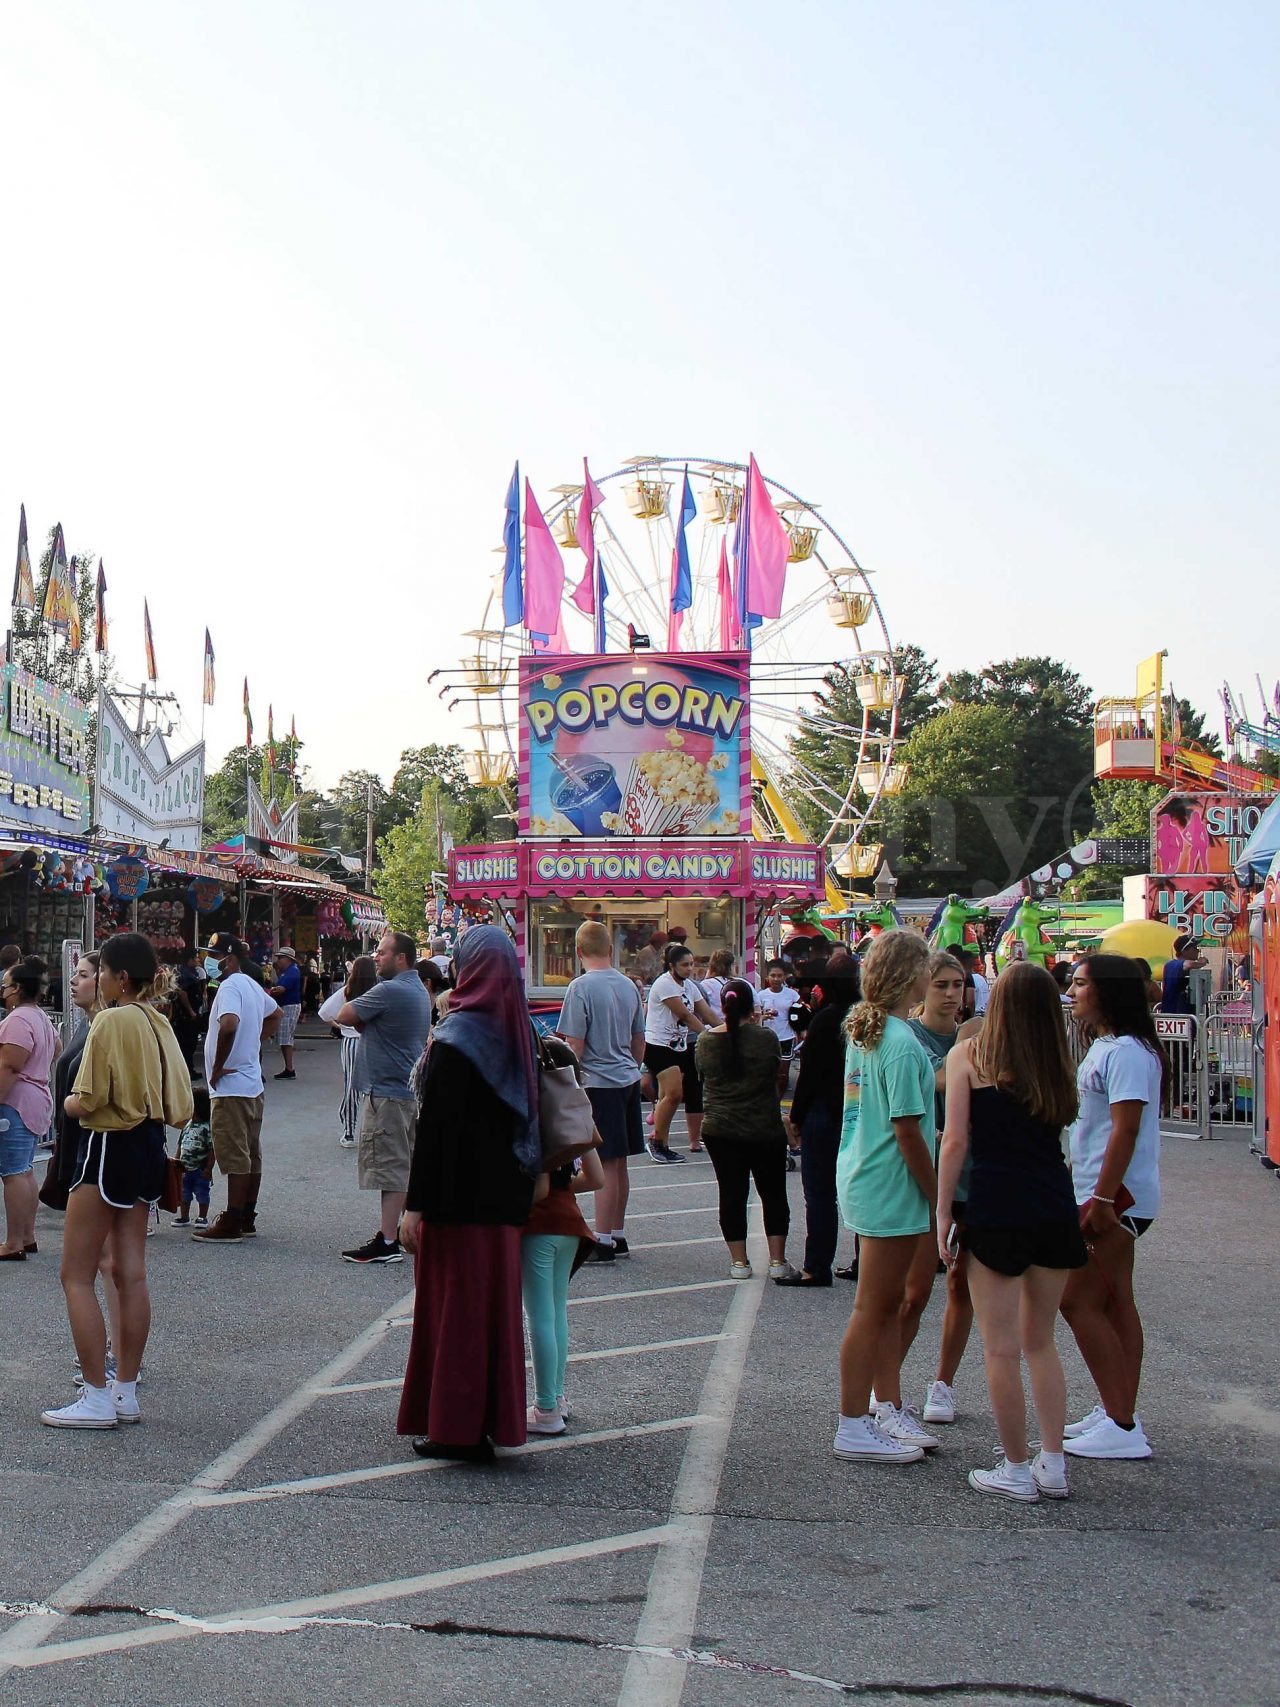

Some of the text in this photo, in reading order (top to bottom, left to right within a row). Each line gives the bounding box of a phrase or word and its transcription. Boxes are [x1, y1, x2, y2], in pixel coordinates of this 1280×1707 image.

[523, 681, 745, 744] POPCORN
[9, 680, 88, 777] WATER
[102, 725, 198, 814] PRIZE PALACE
[1206, 806, 1261, 835] SHO
[456, 857, 518, 882] SLUSHIE
[536, 854, 734, 880] COTTON CANDY
[751, 855, 817, 882] SLUSHIE
[1158, 890, 1241, 914] WIN
[1167, 913, 1233, 937] BIG
[1156, 1021, 1186, 1033] EXIT
